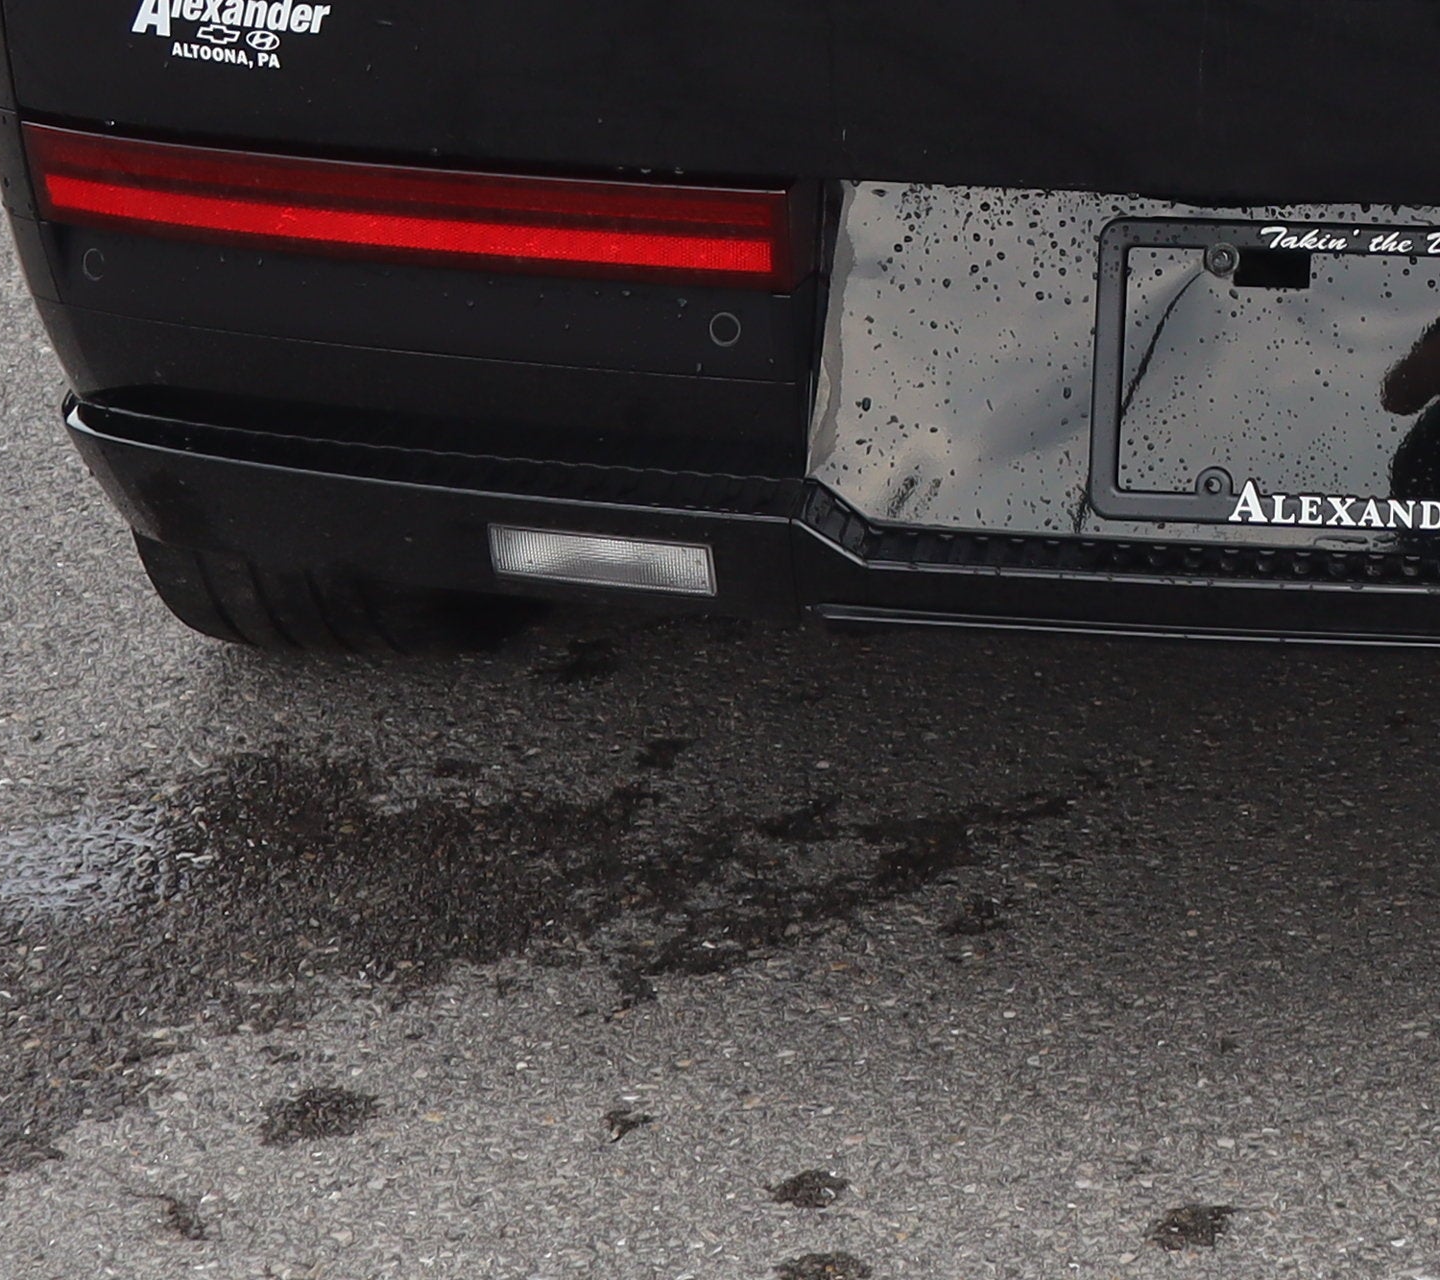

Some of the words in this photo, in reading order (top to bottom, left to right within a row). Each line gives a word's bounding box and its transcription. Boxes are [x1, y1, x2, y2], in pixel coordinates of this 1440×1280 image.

[171, 41, 254, 69] ALTOONA,
[257, 52, 281, 69] PA
[1260, 226, 1360, 251] Takin'
[1369, 231, 1413, 253] the
